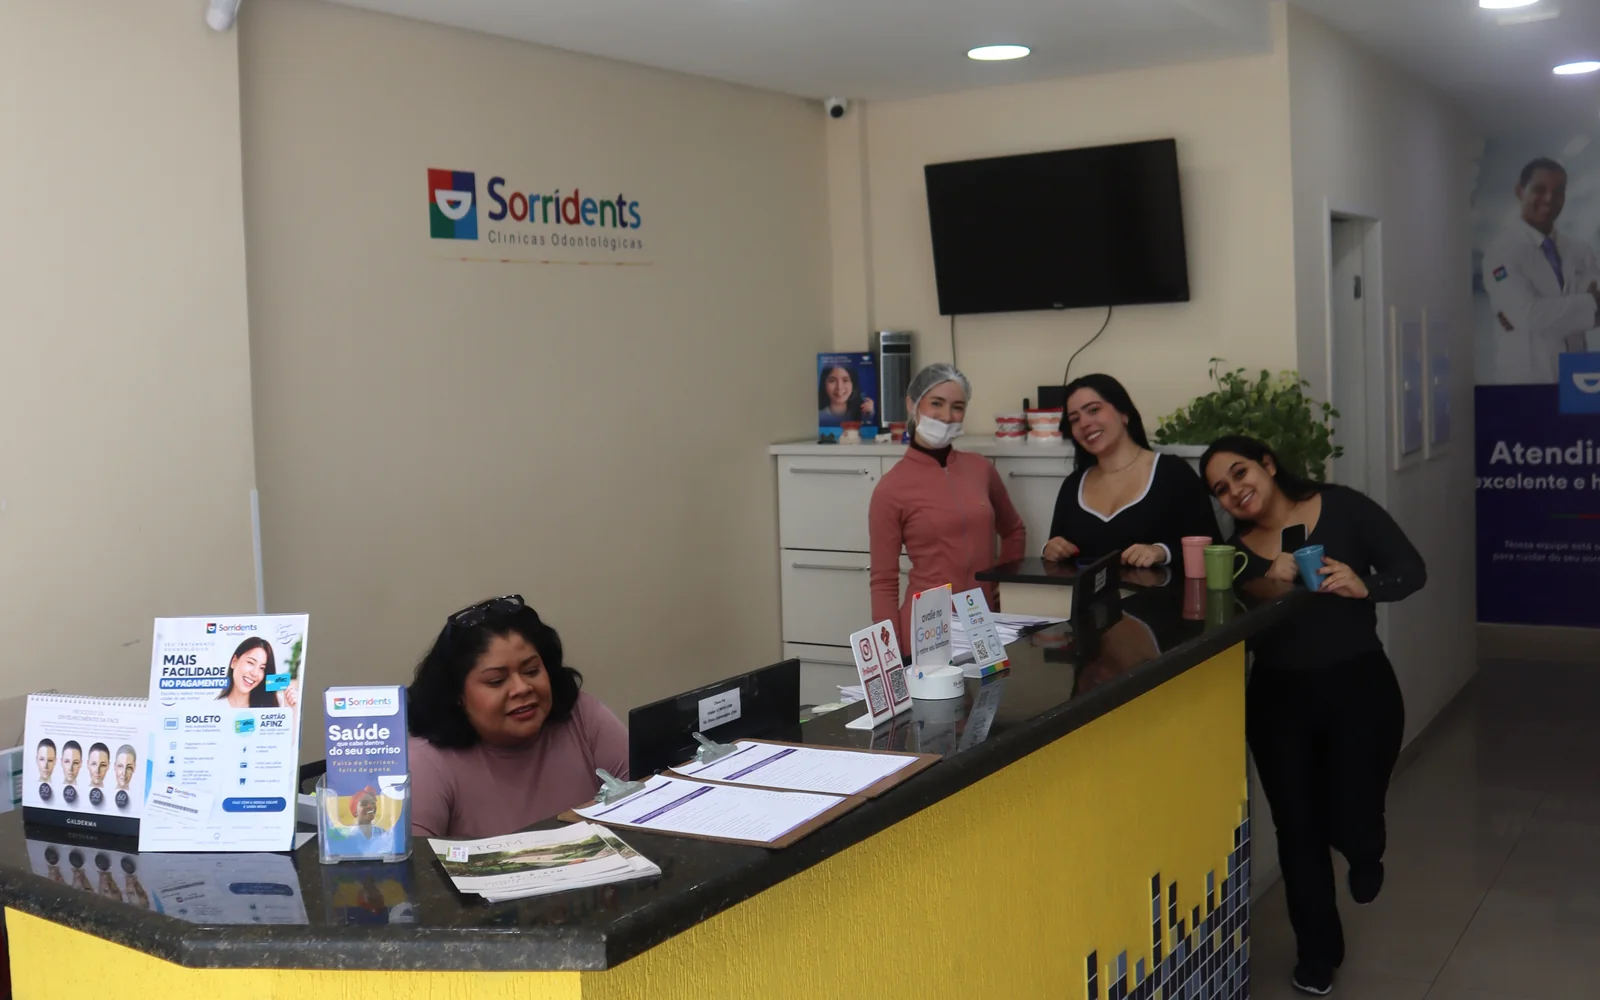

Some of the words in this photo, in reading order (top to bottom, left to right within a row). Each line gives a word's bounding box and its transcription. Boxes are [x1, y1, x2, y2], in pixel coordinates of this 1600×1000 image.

[1573, 476, 1586, 490] e
[219, 623, 257, 632] Sorridents
[917, 619, 949, 643] Google
[163, 655, 197, 665] MAIS
[162, 667, 226, 676] FACILIDADE
[161, 679, 175, 688] NO
[175, 679, 228, 688] PAGAMENTO!
[348, 697, 392, 706] Sorridents
[186, 715, 221, 723] BOLETO
[328, 723, 391, 741] Saúde
[329, 747, 343, 756] do
[365, 745, 401, 755] sorriso
[91, 790, 100, 798] 50
[117, 793, 126, 801] 60
[66, 818, 97, 827] GALDERMA
